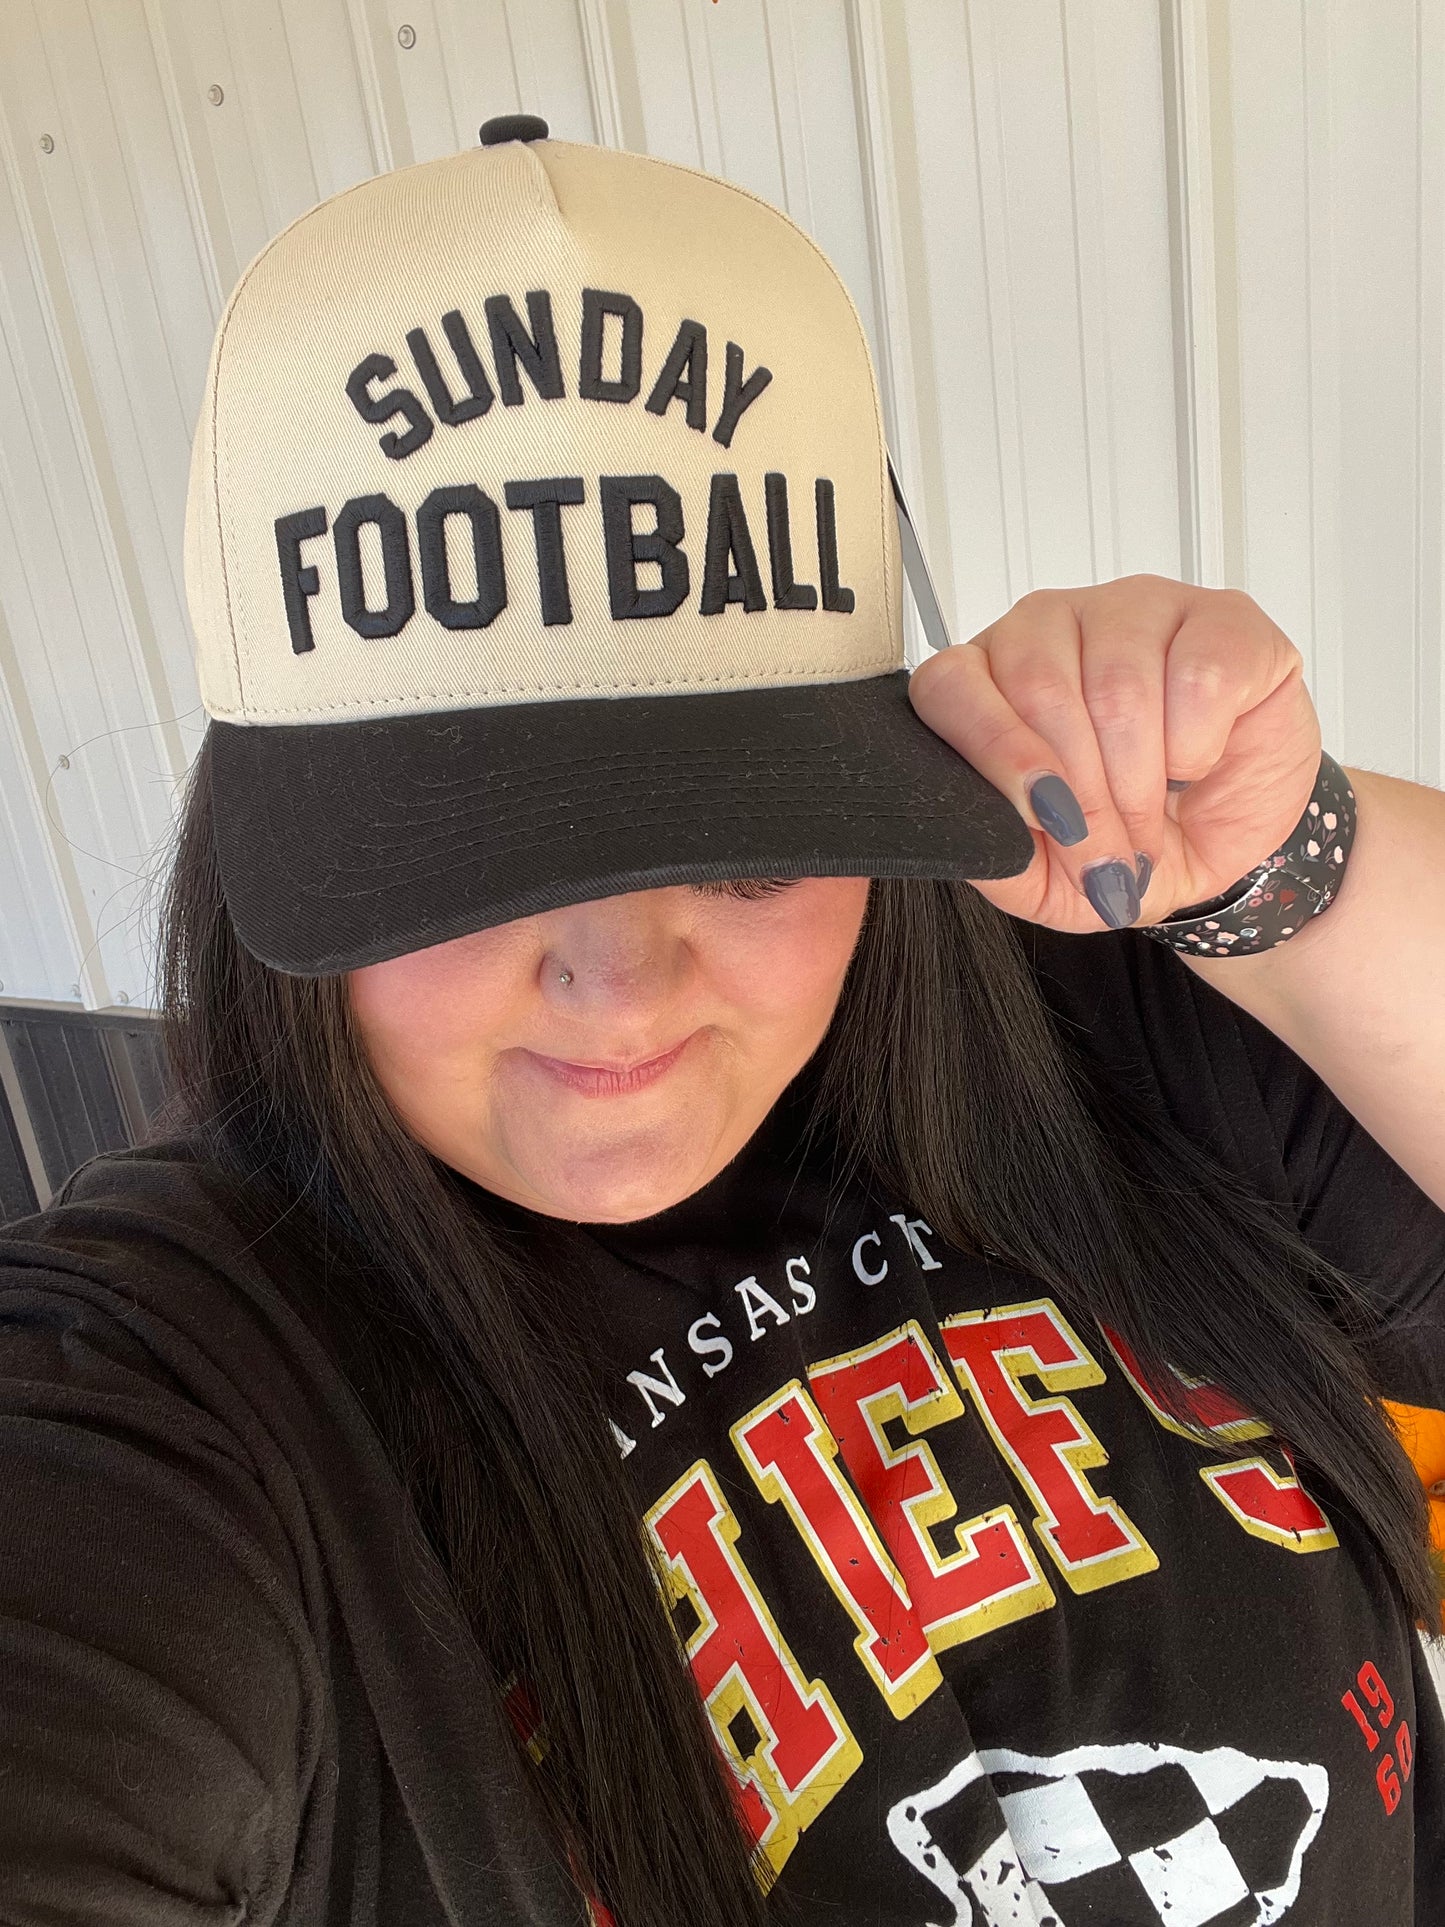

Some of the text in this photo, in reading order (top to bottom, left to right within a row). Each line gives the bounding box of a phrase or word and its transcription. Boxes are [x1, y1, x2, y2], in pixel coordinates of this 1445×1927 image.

[345, 288, 773, 460] SUNDAY
[274, 472, 856, 655] FOOTBALL
[608, 1255, 817, 1459] NSAS
[642, 1297, 1340, 1898] HIEFS
[1341, 1660, 1395, 1752] 19
[1376, 1720, 1413, 1816] 60
